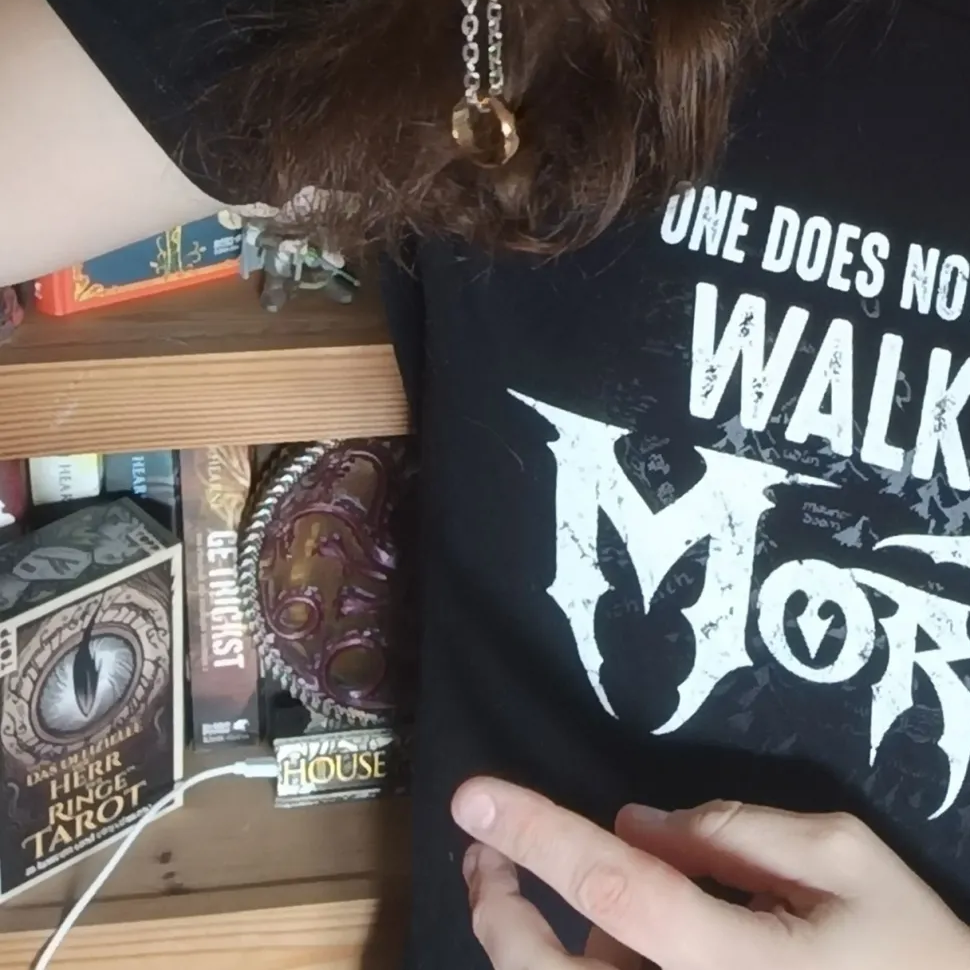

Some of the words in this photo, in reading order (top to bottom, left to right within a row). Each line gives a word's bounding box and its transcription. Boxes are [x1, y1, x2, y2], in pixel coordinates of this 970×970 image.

[659, 184, 758, 264] ONE
[761, 204, 890, 299] DOES
[131, 455, 148, 497] HEAR
[49, 750, 123, 801] HERR
[279, 749, 388, 788] HOUSE
[20, 778, 148, 860] TAROT
